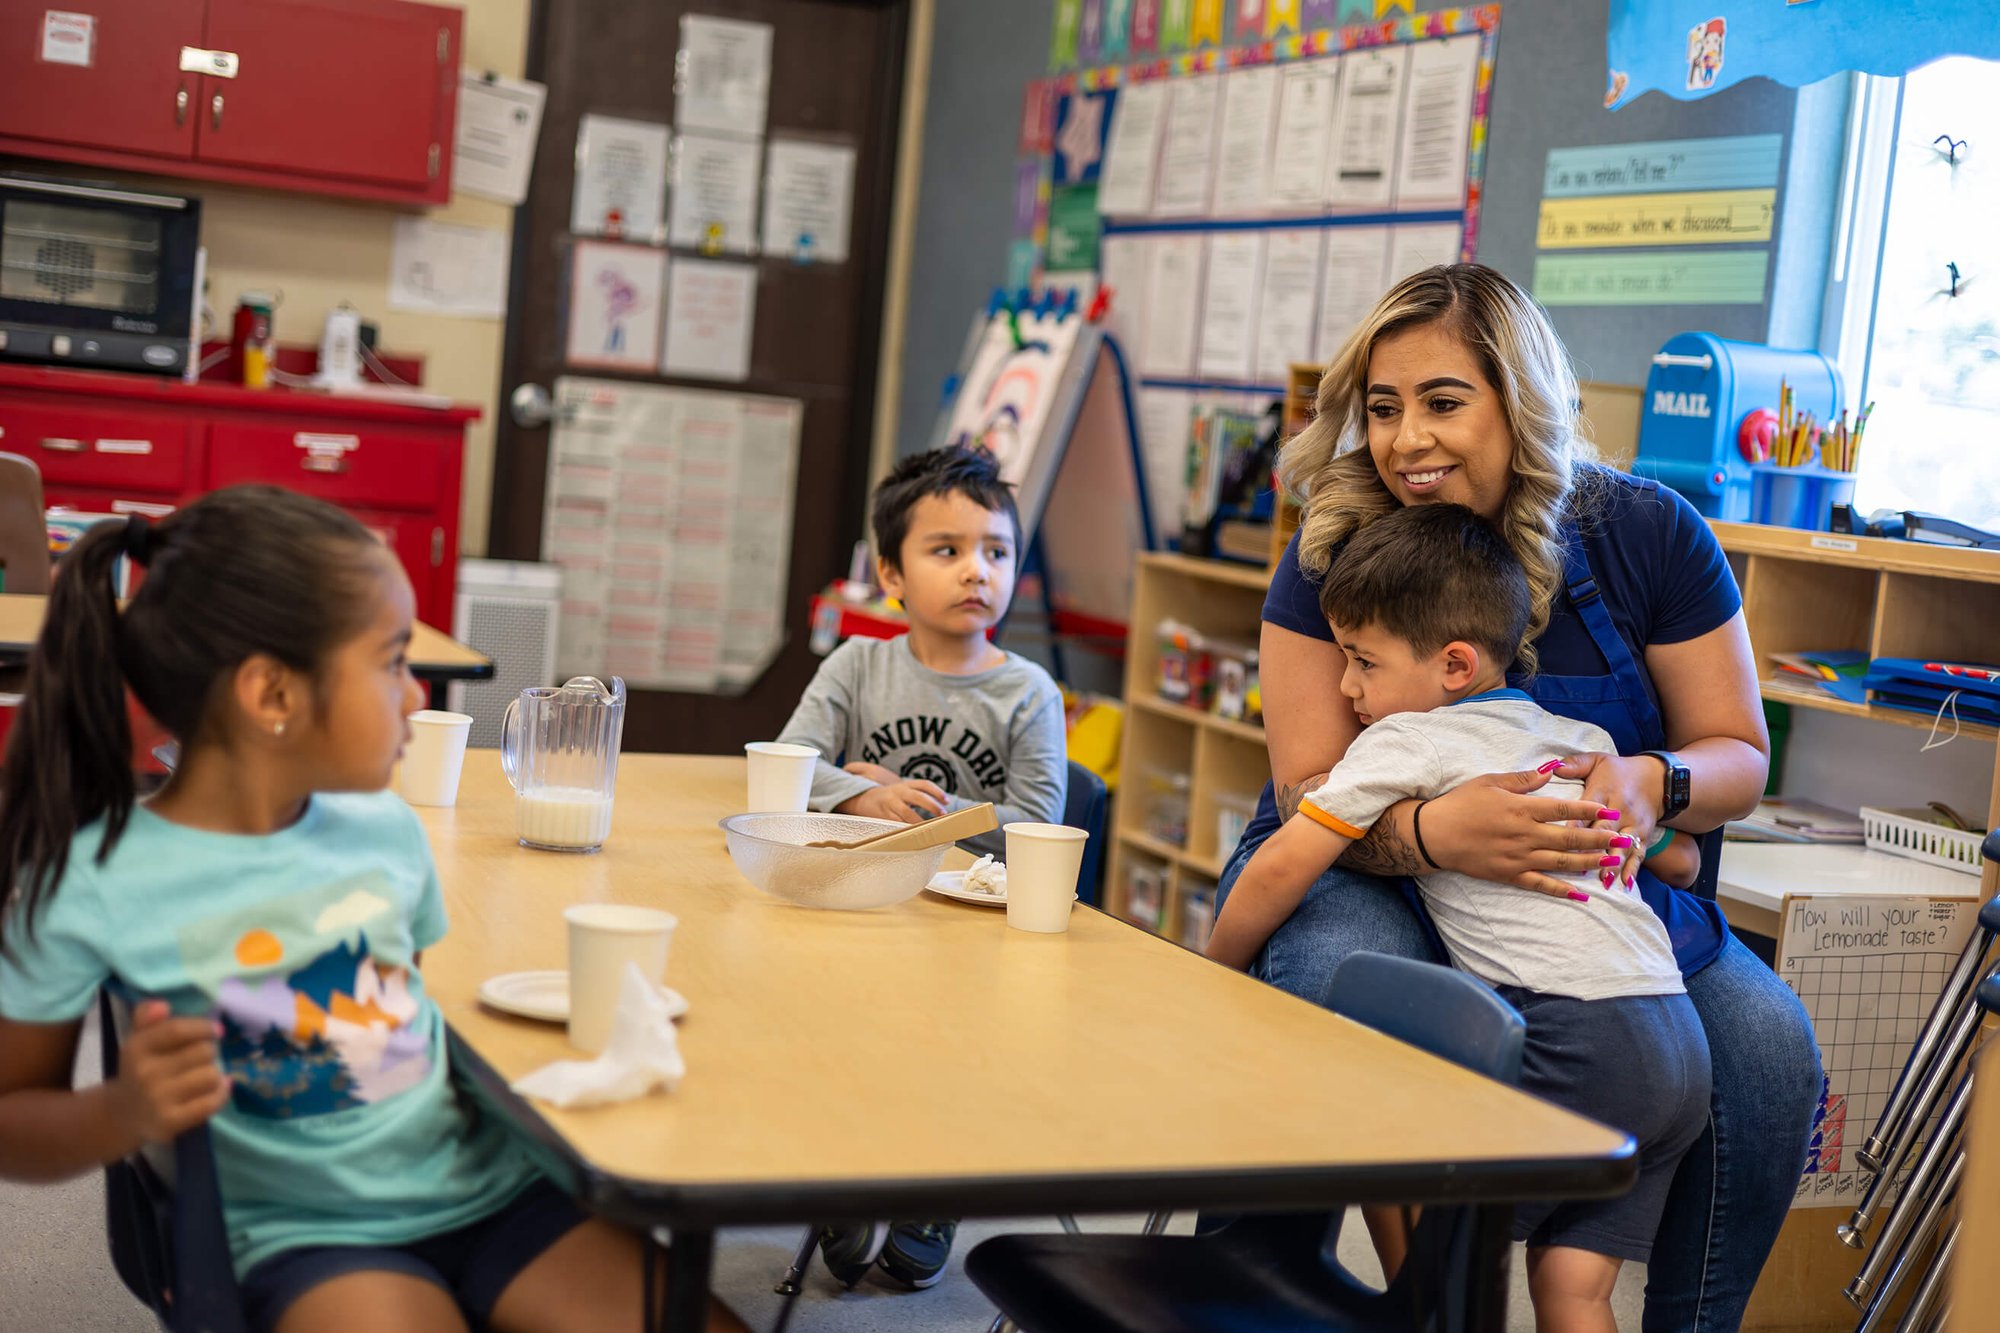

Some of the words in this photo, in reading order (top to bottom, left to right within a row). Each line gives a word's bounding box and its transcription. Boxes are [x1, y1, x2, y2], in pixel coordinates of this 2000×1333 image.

[1652, 391, 1711, 418] MAIL
[862, 715, 952, 765] SNOW
[950, 728, 1007, 790] DAY
[1792, 902, 1828, 933] How
[1841, 905, 1870, 927] will
[1881, 908, 1921, 932] your
[1814, 928, 1889, 951] Lemonade
